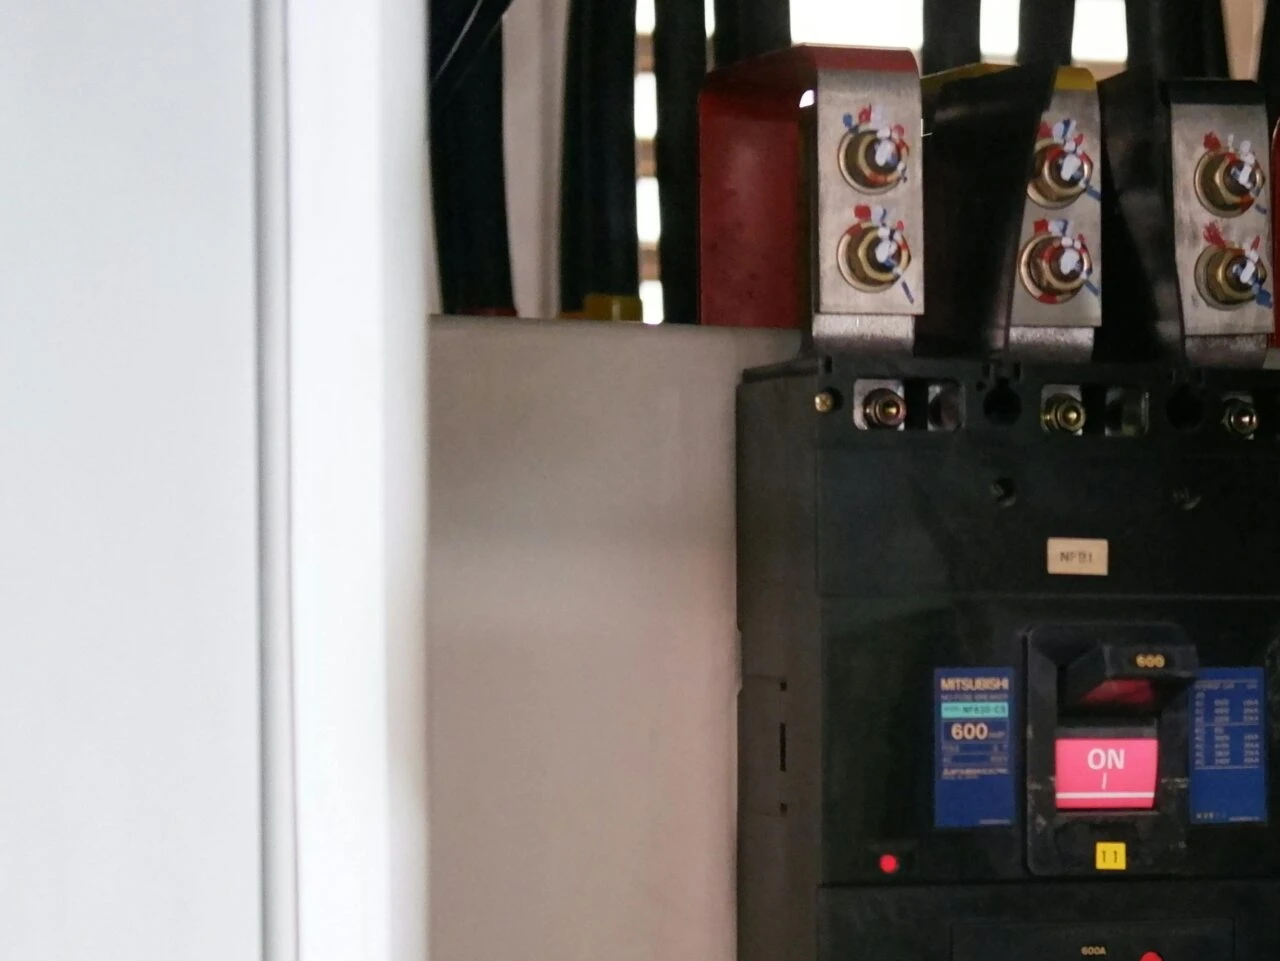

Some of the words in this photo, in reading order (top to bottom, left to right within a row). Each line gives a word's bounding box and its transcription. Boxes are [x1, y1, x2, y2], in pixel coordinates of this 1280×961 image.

[1136, 653, 1165, 668] 600
[940, 677, 1009, 691] MITSUBISHI
[951, 722, 988, 740] 600
[1087, 748, 1125, 770] ON
[1102, 849, 1118, 864] 11
